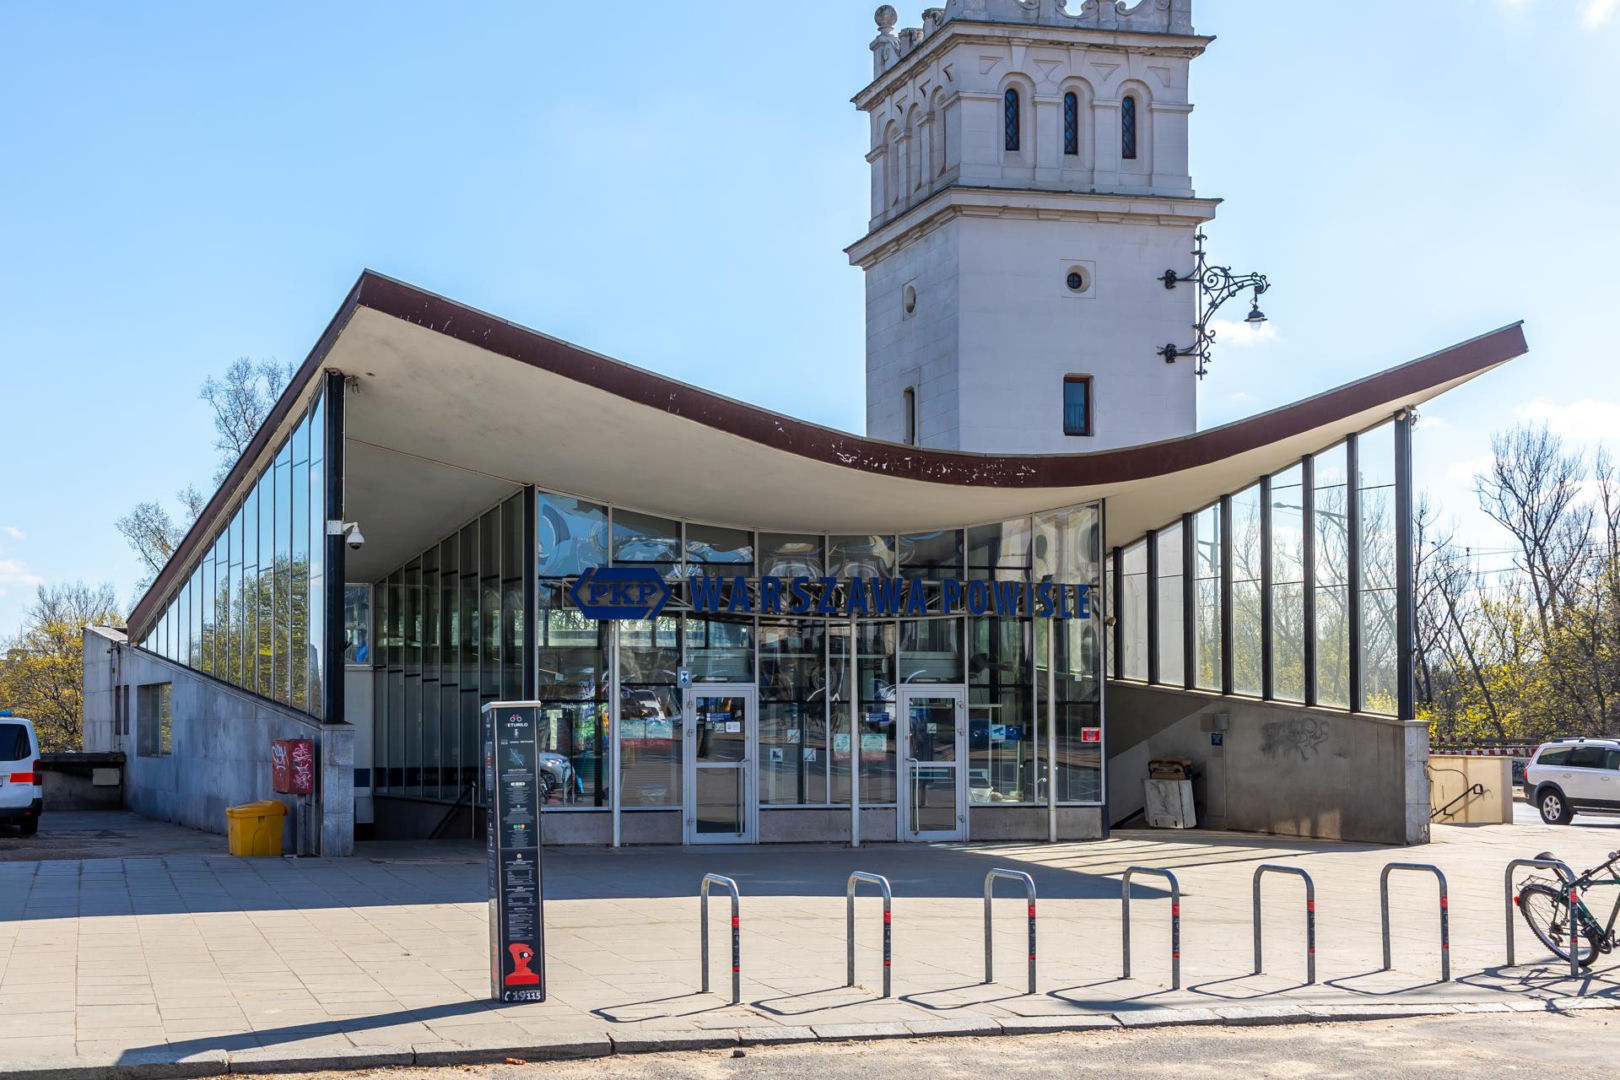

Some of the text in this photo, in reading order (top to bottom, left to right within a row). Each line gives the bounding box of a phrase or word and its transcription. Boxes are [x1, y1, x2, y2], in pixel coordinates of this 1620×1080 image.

[588, 583, 658, 605] PKP
[689, 574, 1091, 619] WARSZAWA POWIŚLE
